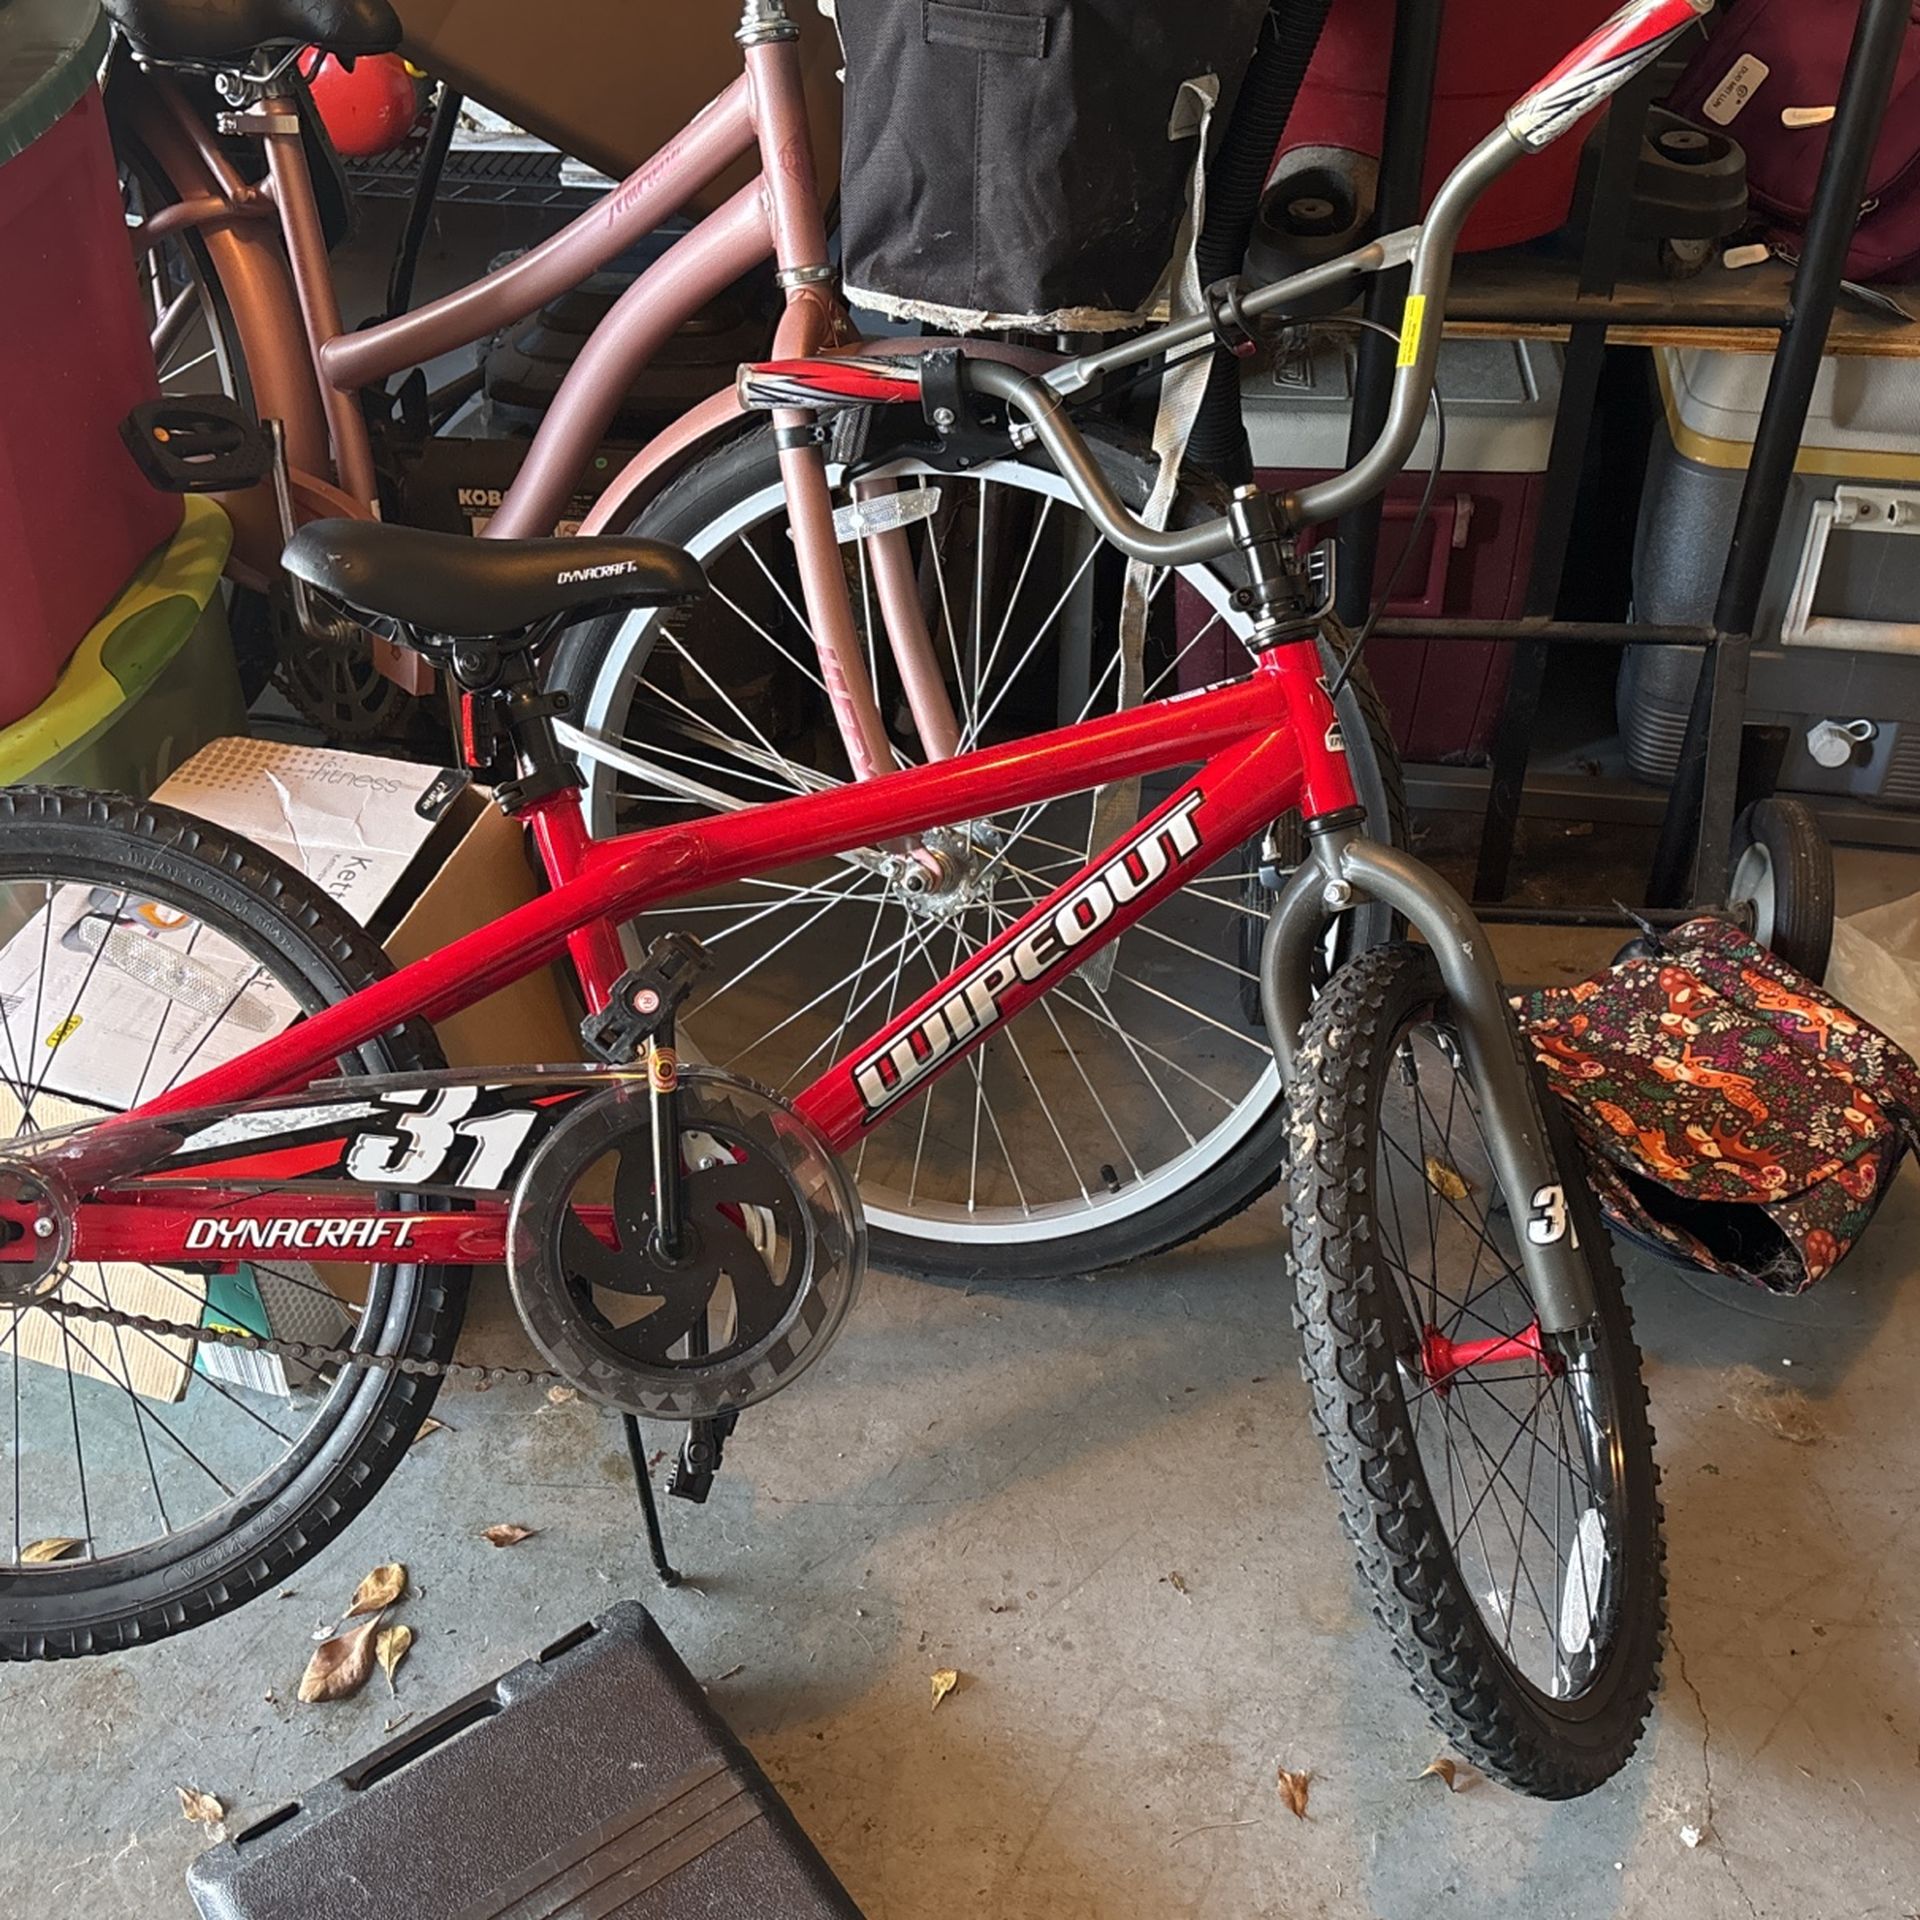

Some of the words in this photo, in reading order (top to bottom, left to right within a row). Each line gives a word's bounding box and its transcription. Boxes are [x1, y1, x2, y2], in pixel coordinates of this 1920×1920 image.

[458, 488, 508, 507] KOB
[557, 560, 636, 584] DYNACRAFT
[312, 760, 402, 793] fitness
[853, 790, 1204, 1111] WIPEOUT
[346, 1086, 538, 1190] 31
[185, 1217, 415, 1249] DYNACRAFT
[1527, 1184, 1580, 1250] 3
